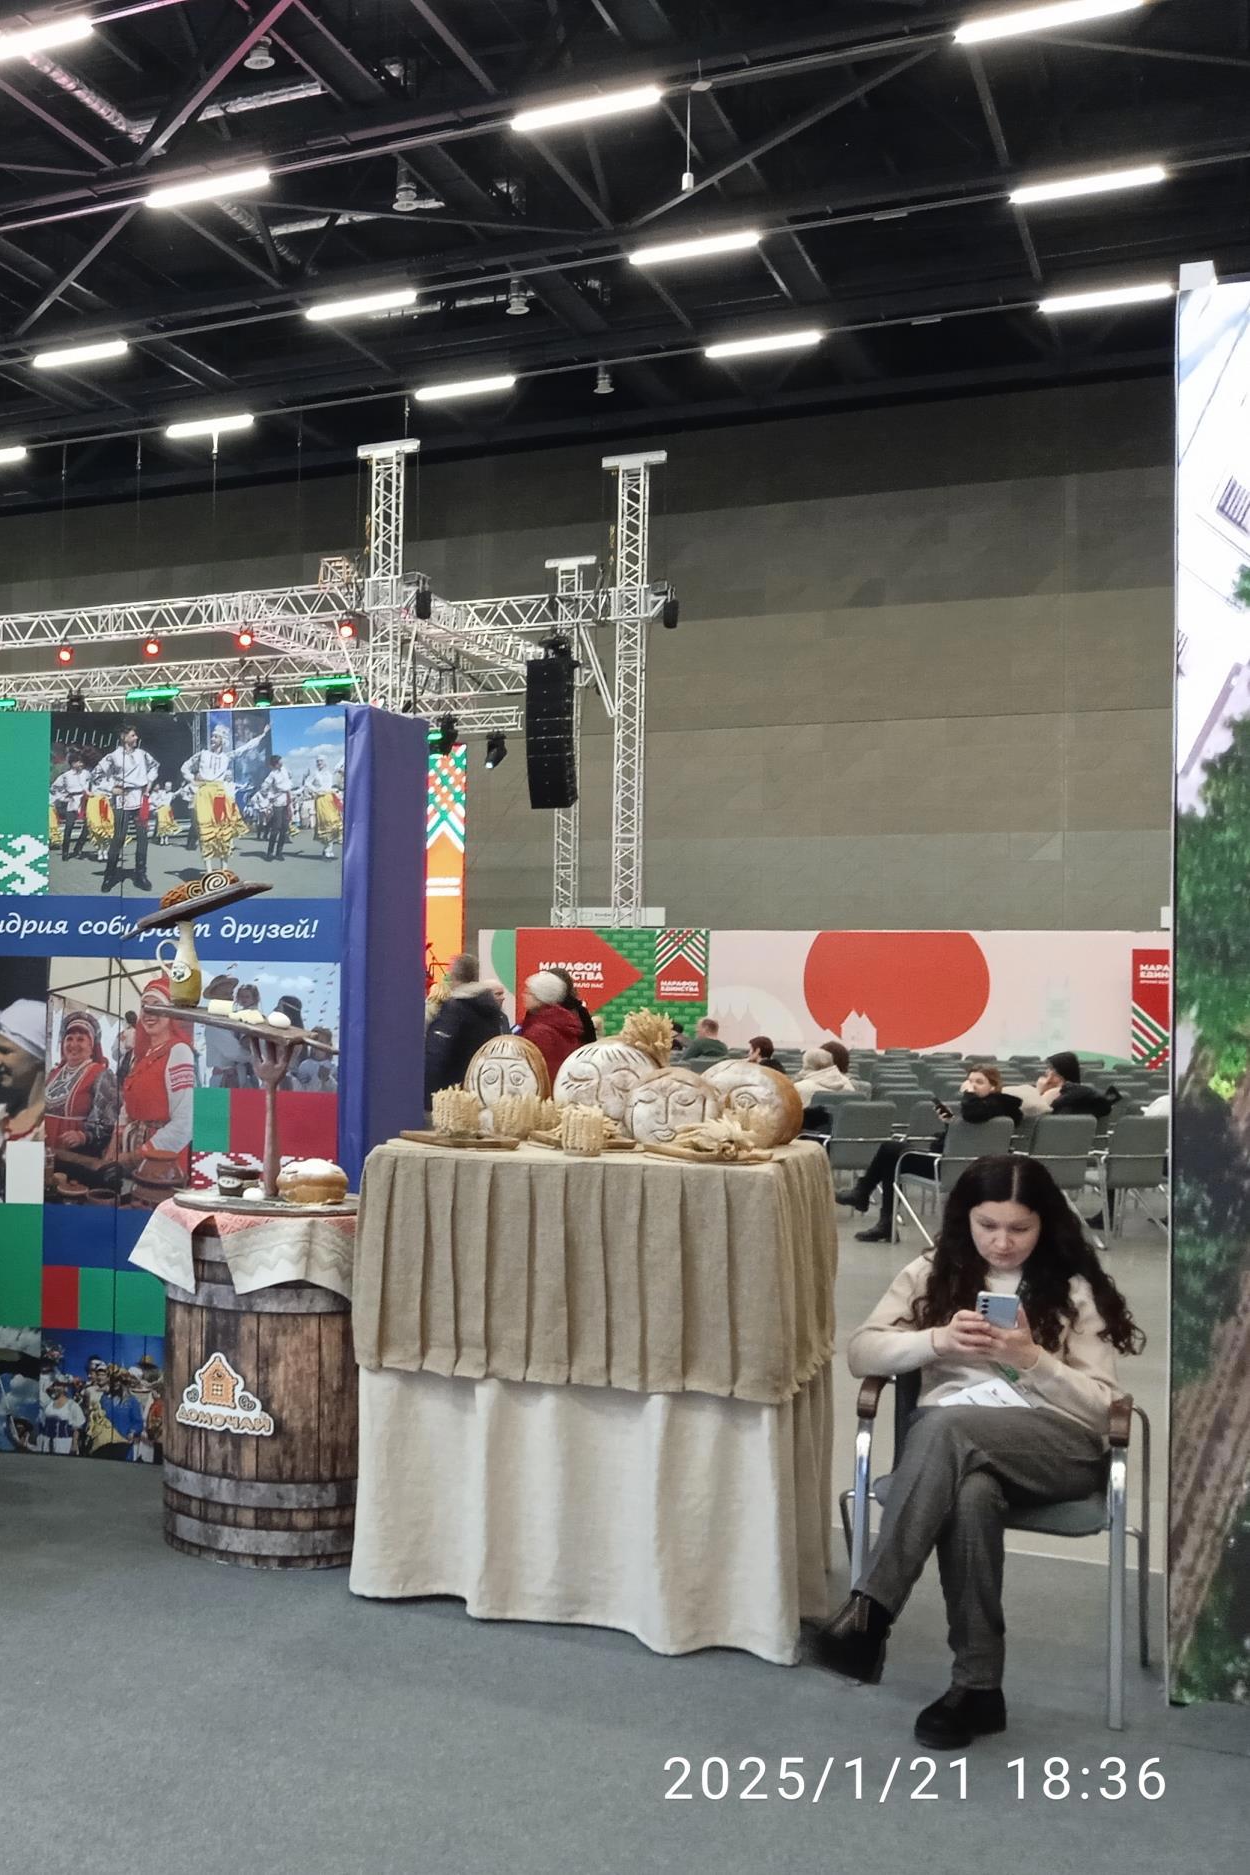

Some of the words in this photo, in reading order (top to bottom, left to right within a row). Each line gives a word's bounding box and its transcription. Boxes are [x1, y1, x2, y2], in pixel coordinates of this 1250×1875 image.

[220, 916, 319, 944] друзей!
[539, 962, 602, 971] МАРАФОН
[177, 1405, 271, 1433] ДОМОЧАЙ
